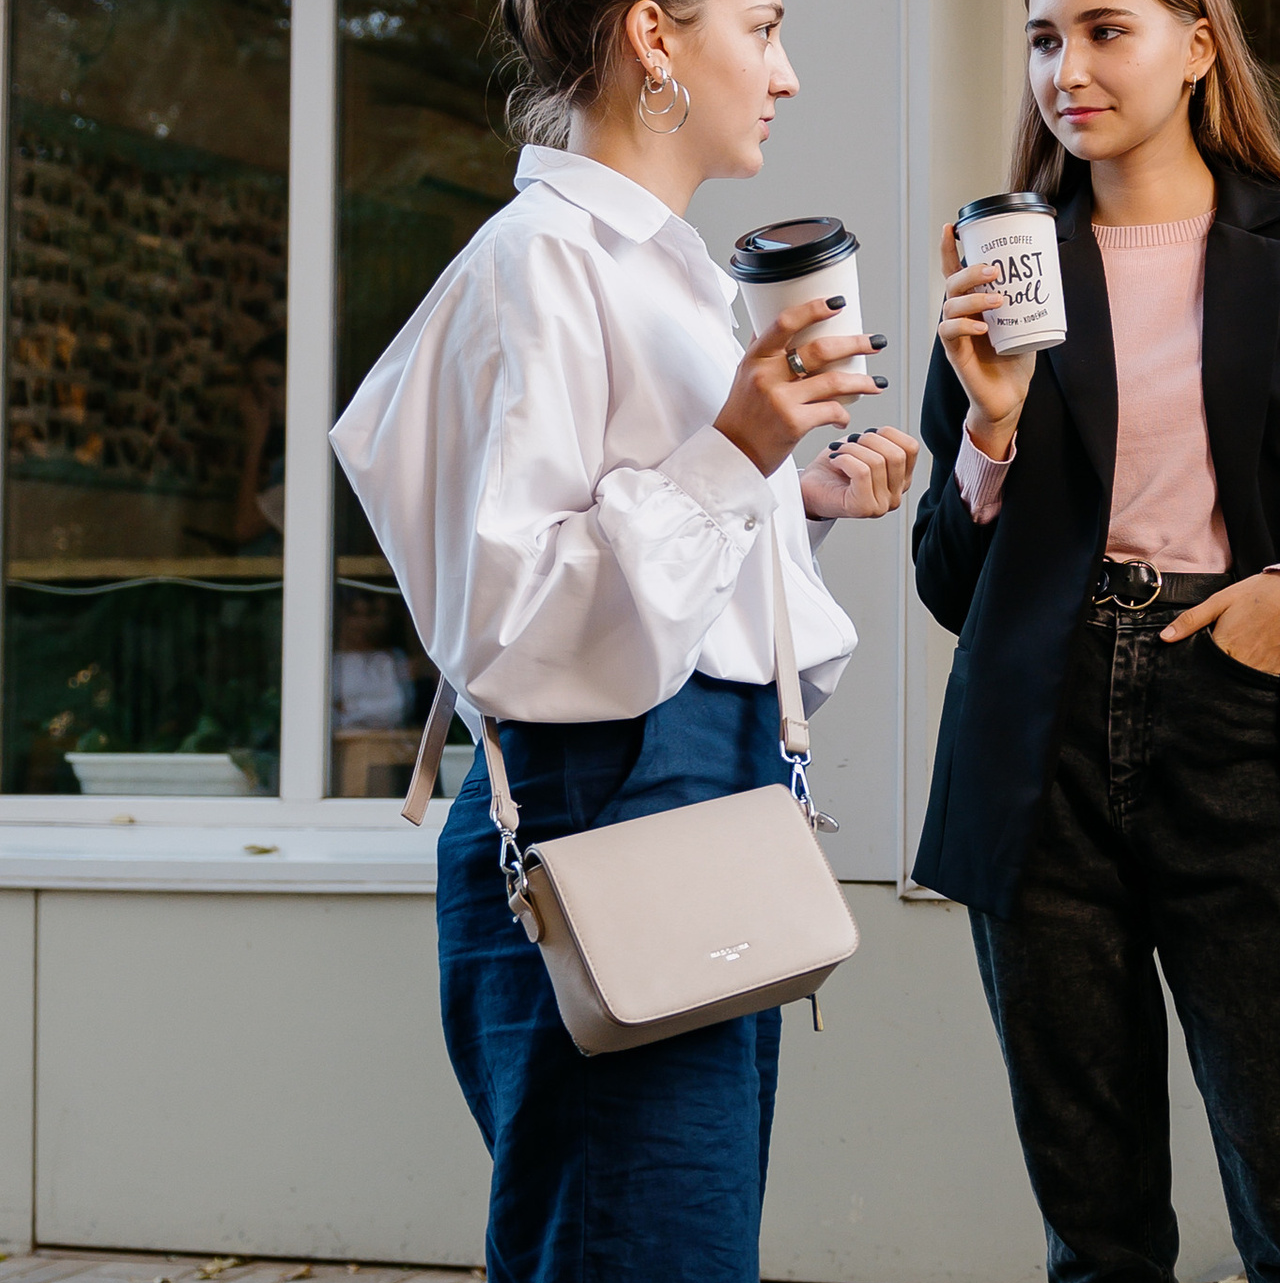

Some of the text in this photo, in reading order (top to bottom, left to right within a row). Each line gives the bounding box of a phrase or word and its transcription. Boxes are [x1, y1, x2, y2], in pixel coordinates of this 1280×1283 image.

[981, 235, 1033, 253] CRAFTED COFFEE
[982, 252, 1042, 290] OAST
